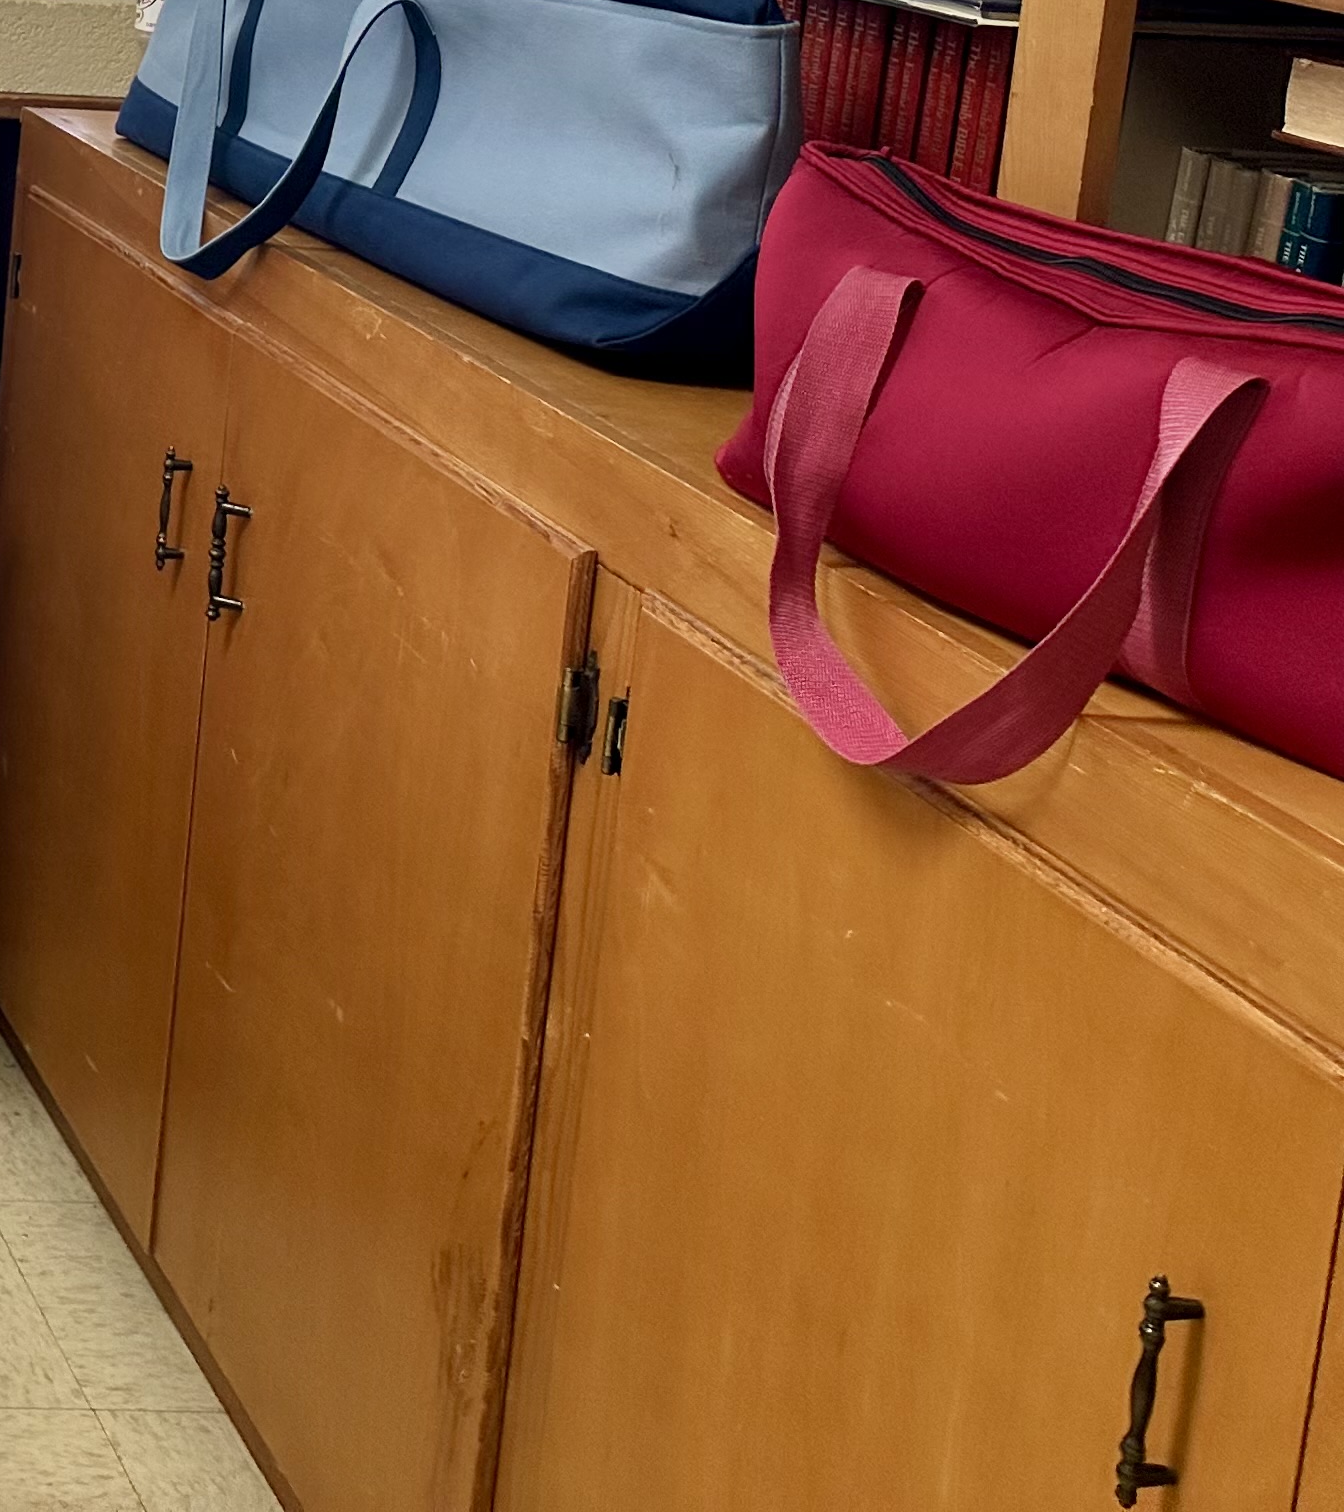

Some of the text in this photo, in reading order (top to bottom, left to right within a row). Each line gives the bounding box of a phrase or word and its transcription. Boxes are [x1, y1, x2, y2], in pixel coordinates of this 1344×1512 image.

[967, 45, 981, 70] The
[1282, 242, 1293, 263] THE
[1297, 244, 1308, 265] THE
